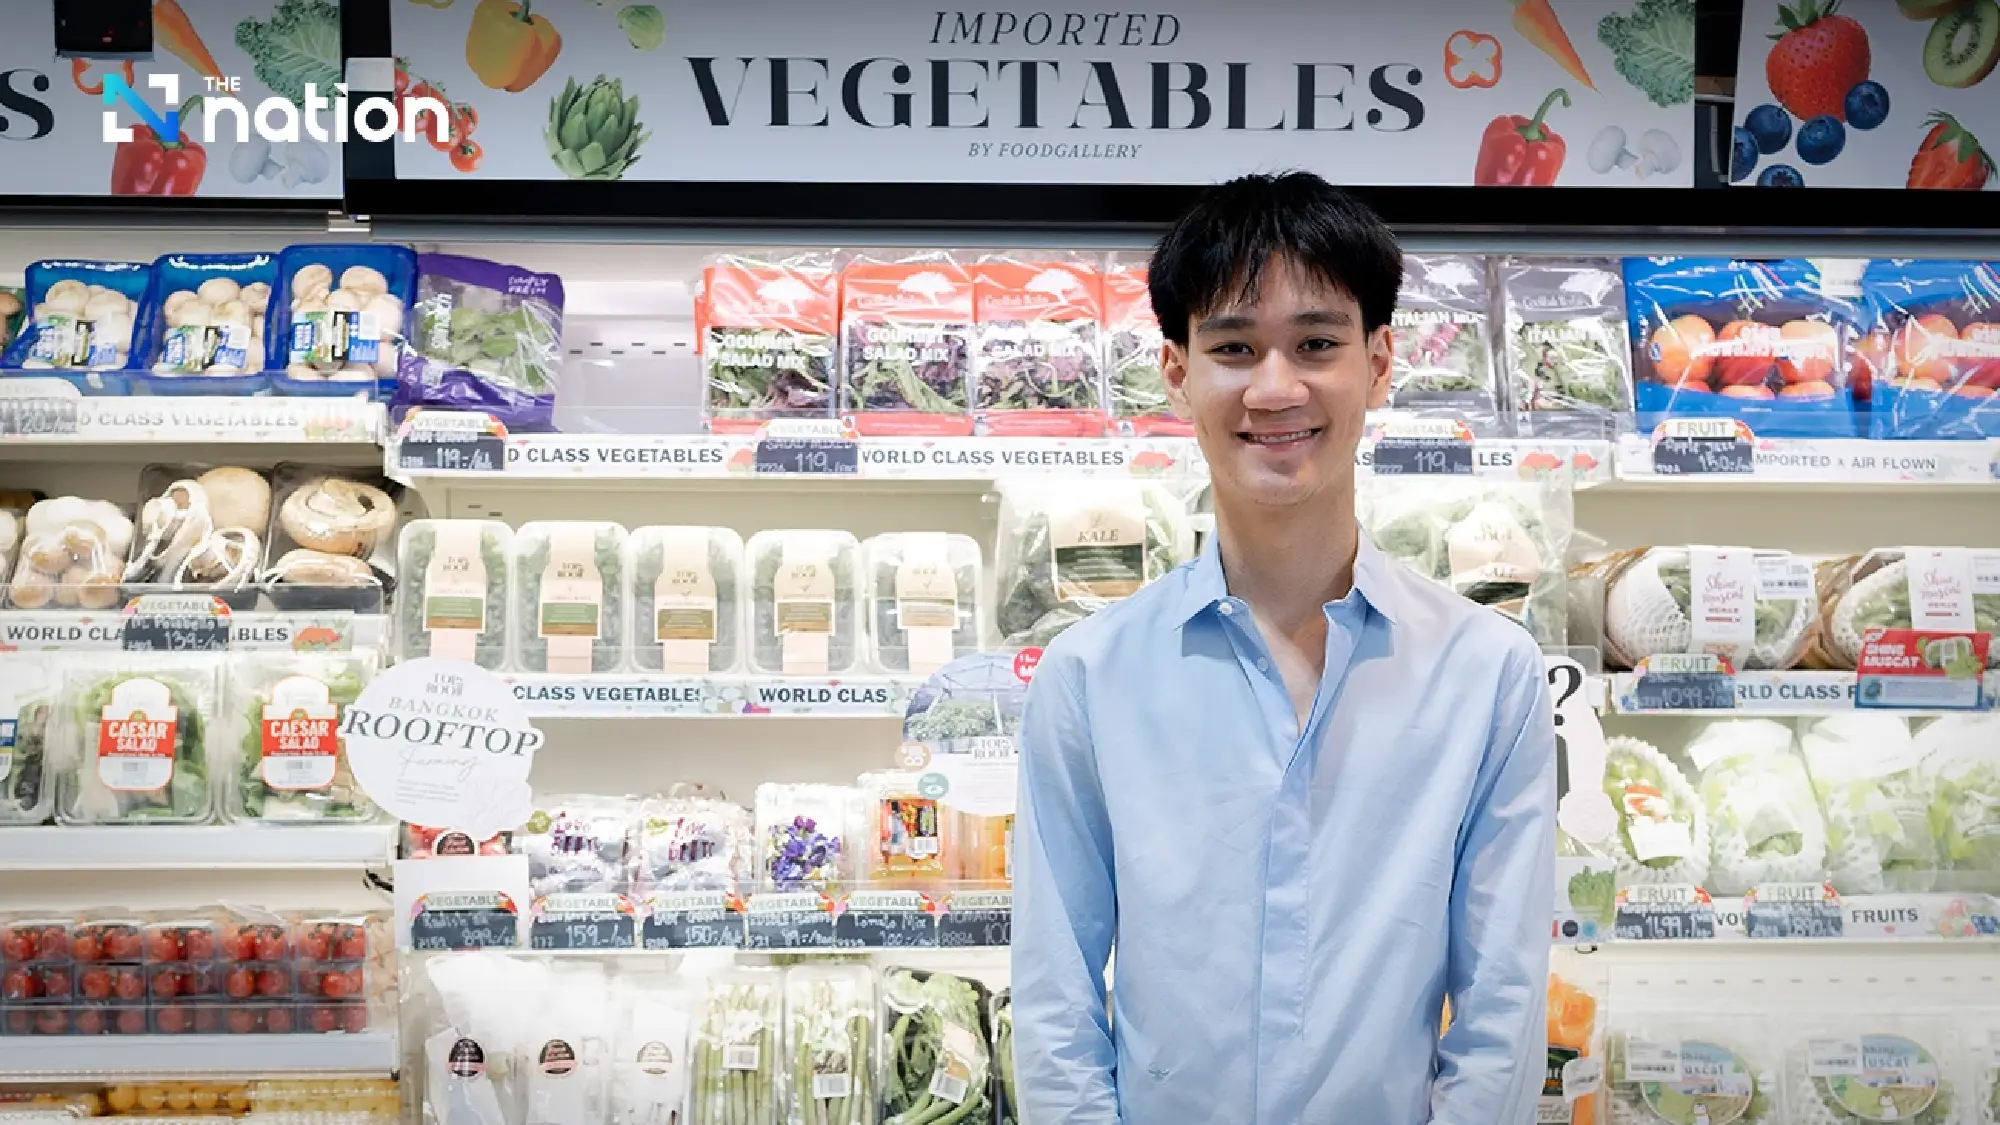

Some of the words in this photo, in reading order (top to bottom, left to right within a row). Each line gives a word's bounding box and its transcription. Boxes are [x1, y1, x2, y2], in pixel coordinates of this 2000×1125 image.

[930, 12, 1181, 46] IMPORTED
[685, 56, 1426, 132] VEGETABLES
[969, 143, 992, 157] BY
[999, 143, 1142, 158] FOODGALLERY
[722, 354, 773, 367] SALAD
[776, 355, 806, 368] MIX
[864, 347, 916, 361] SALAD
[922, 347, 949, 361] MIX
[100, 413, 164, 427] CLASS
[172, 413, 299, 427] VEGETABLES
[1677, 421, 1728, 435] FRUIT
[528, 449, 590, 462] CLASS
[597, 449, 723, 463] VEGETABLES
[862, 449, 926, 463] WORLD
[932, 450, 994, 464] CLASS
[1002, 450, 1124, 465] VEGETABLES
[1852, 454, 1877, 468] AIR
[1882, 455, 1936, 469] FLOWN
[1077, 529, 1119, 543] KALE
[7, 626, 83, 640] WORLD
[1660, 656, 1712, 670] FRUIT
[1863, 655, 1920, 669] MUSCAT
[513, 685, 576, 701] CLASS
[759, 688, 832, 703] WORLD
[1779, 684, 1841, 699] CLASS
[388, 696, 499, 722] BANGKOK
[108, 721, 168, 739] CAESAR
[265, 720, 330, 738] CAESAR
[344, 708, 539, 757] ROOFTOP
[117, 738, 158, 752] SALAD
[279, 736, 320, 750] SALAD
[1637, 887, 1687, 900] FRUIT
[1767, 885, 1815, 900] FRUIT
[1851, 908, 1919, 923] FRUITS
[1684, 1064, 1724, 1075] uscat
